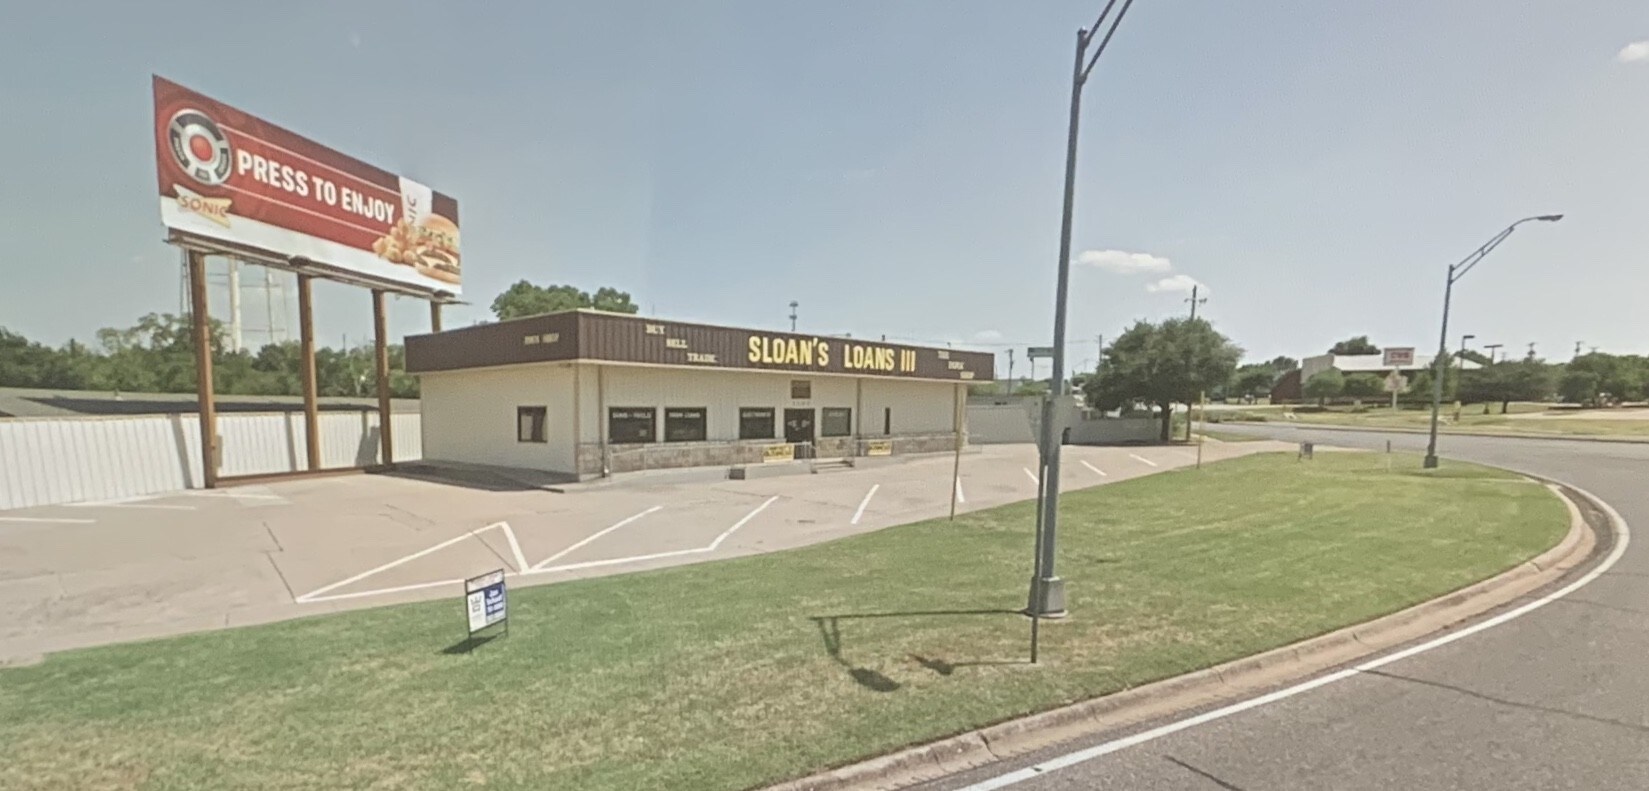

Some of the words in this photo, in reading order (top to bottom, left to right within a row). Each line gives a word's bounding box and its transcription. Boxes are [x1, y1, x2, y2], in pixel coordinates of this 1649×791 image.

[236, 148, 309, 197] PRESS
[311, 176, 337, 206] TO
[341, 187, 395, 225] ENJOY
[179, 195, 228, 217] SONIC
[646, 322, 665, 334] BUY
[666, 338, 688, 348] SELL
[687, 352, 717, 363] TRADE
[748, 335, 829, 367] SLOAN'S
[844, 344, 895, 371] LOANS
[900, 349, 916, 372] III
